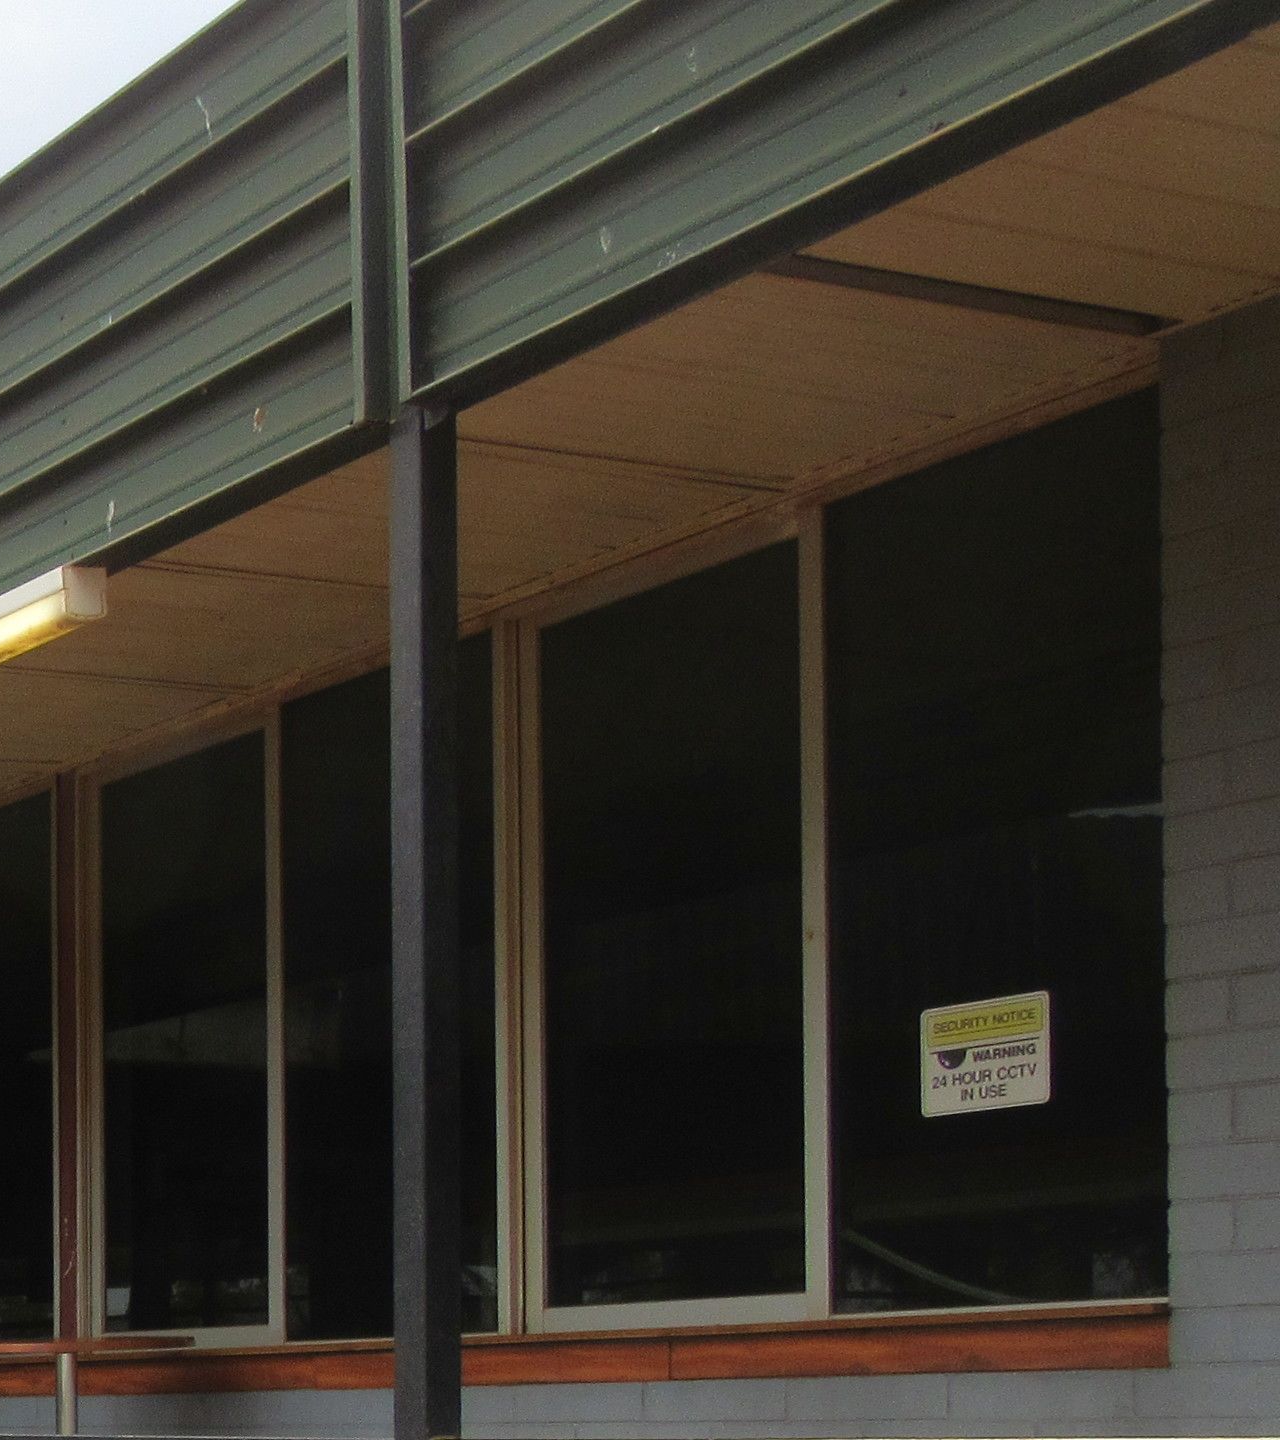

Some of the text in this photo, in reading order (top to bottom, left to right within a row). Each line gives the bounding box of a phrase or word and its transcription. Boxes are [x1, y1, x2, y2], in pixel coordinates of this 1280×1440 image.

[932, 1008, 1037, 1035] SECURITY NOTICE
[972, 1043, 1037, 1062] WARNING
[931, 1063, 1038, 1090] 24 HOUR CCTV
[960, 1084, 1008, 1101] IN USE
